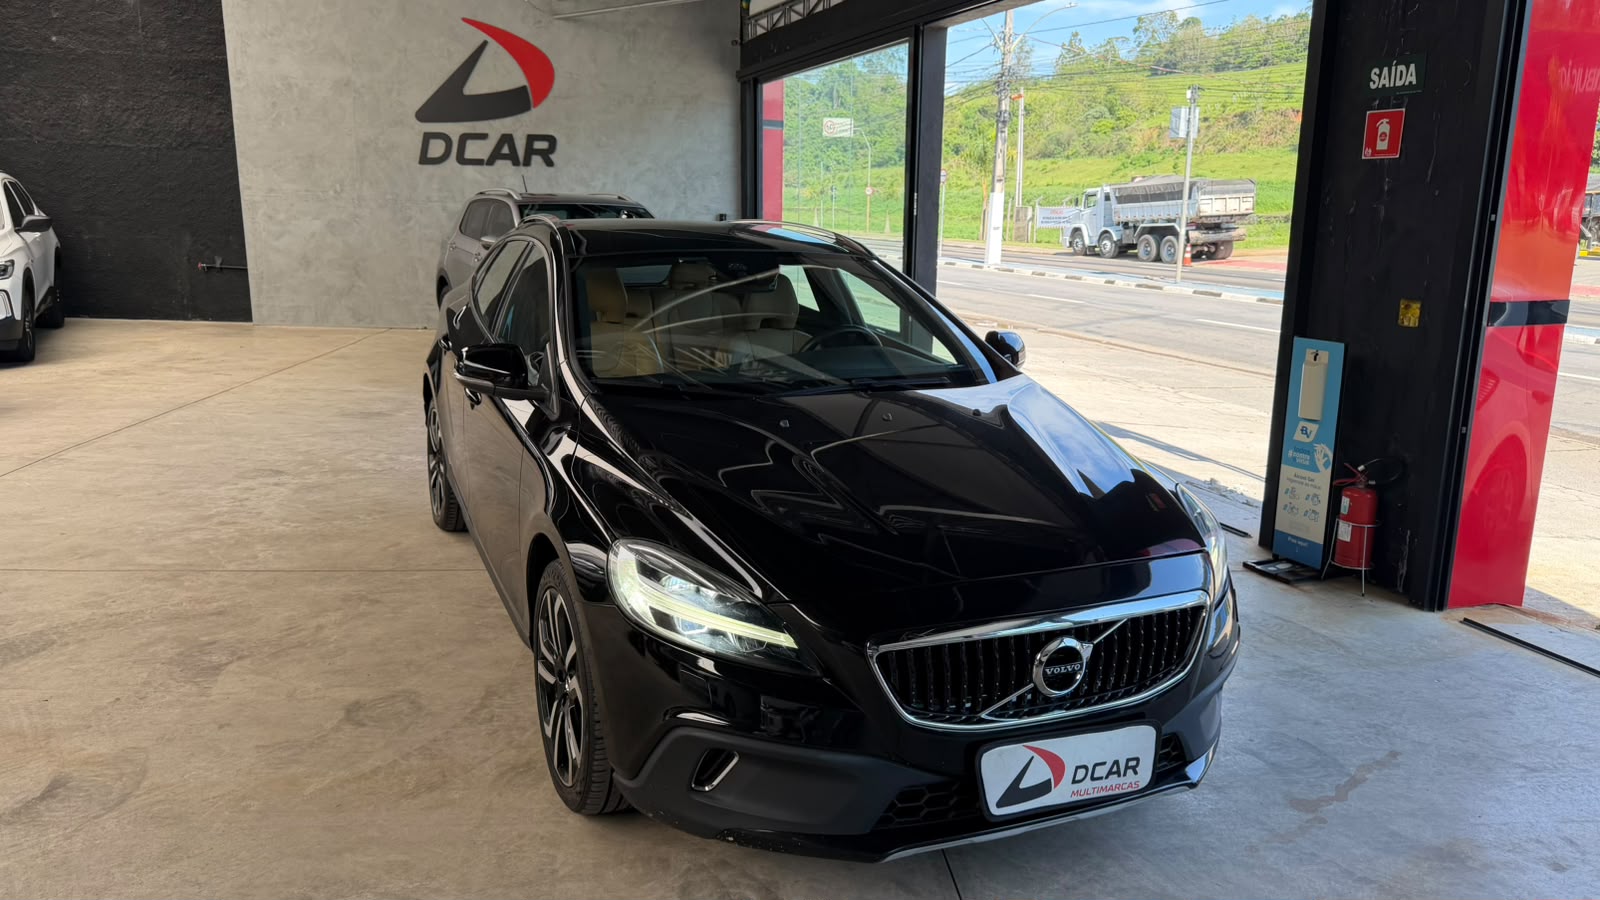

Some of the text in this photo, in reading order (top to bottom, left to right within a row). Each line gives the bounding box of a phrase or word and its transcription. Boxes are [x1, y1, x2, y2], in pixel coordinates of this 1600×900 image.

[1369, 60, 1417, 90] SAÍDA
[418, 131, 557, 167] DCAR
[1045, 663, 1081, 675] VOLVO
[1071, 756, 1140, 785] DCAR
[1070, 780, 1140, 798] MULTIMARCAS
